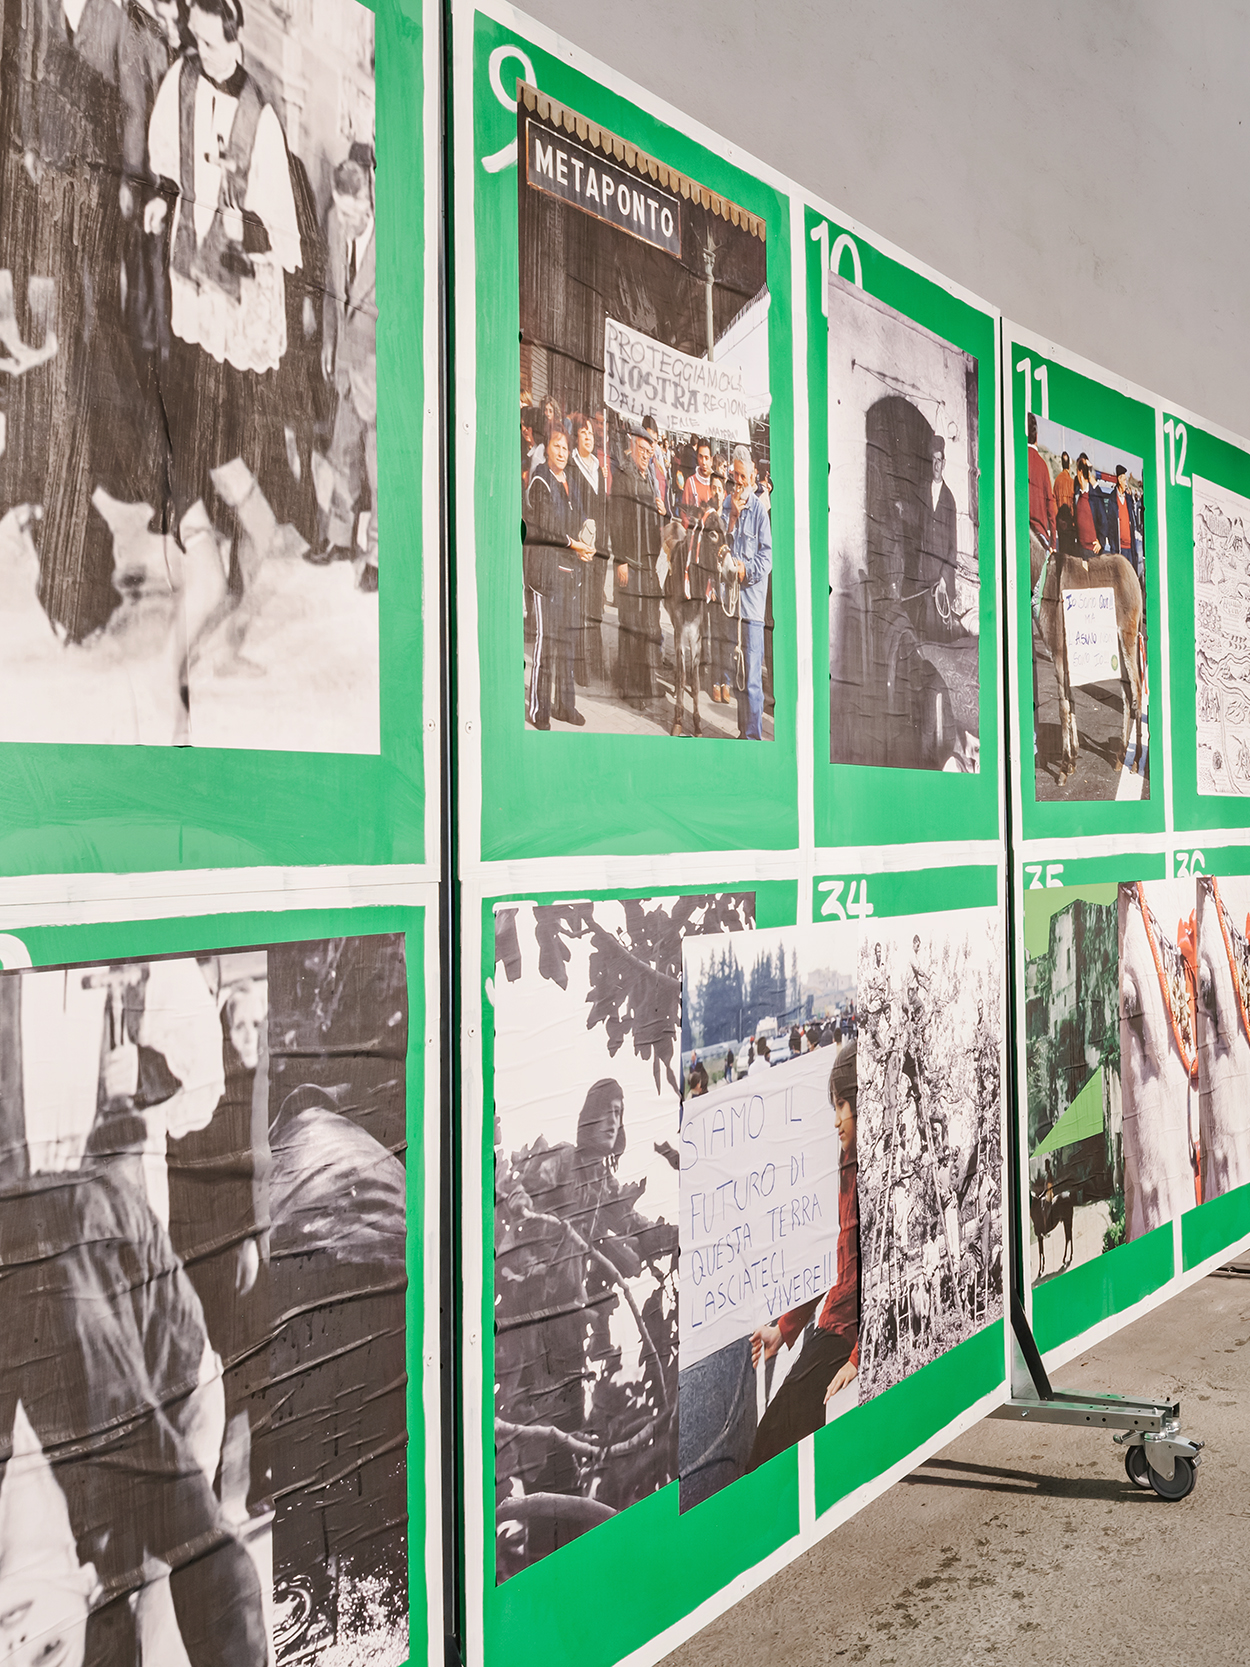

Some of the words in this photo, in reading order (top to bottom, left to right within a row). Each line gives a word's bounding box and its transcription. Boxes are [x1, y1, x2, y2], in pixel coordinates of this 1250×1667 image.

[535, 138, 674, 238] METAPONTO
[606, 350, 700, 413] NOSTRA
[1163, 418, 1191, 488] 12
[817, 879, 874, 920] 34
[681, 1094, 765, 1171] SIAMO
[785, 1086, 802, 1125] IL
[690, 1162, 776, 1240] FUTURO
[790, 1151, 805, 1186] DI
[691, 1222, 753, 1287] QUESTA
[766, 1193, 823, 1242] TERRA
[691, 1248, 786, 1328] LASCIATECI
[764, 1251, 832, 1316] VIVERE!!
